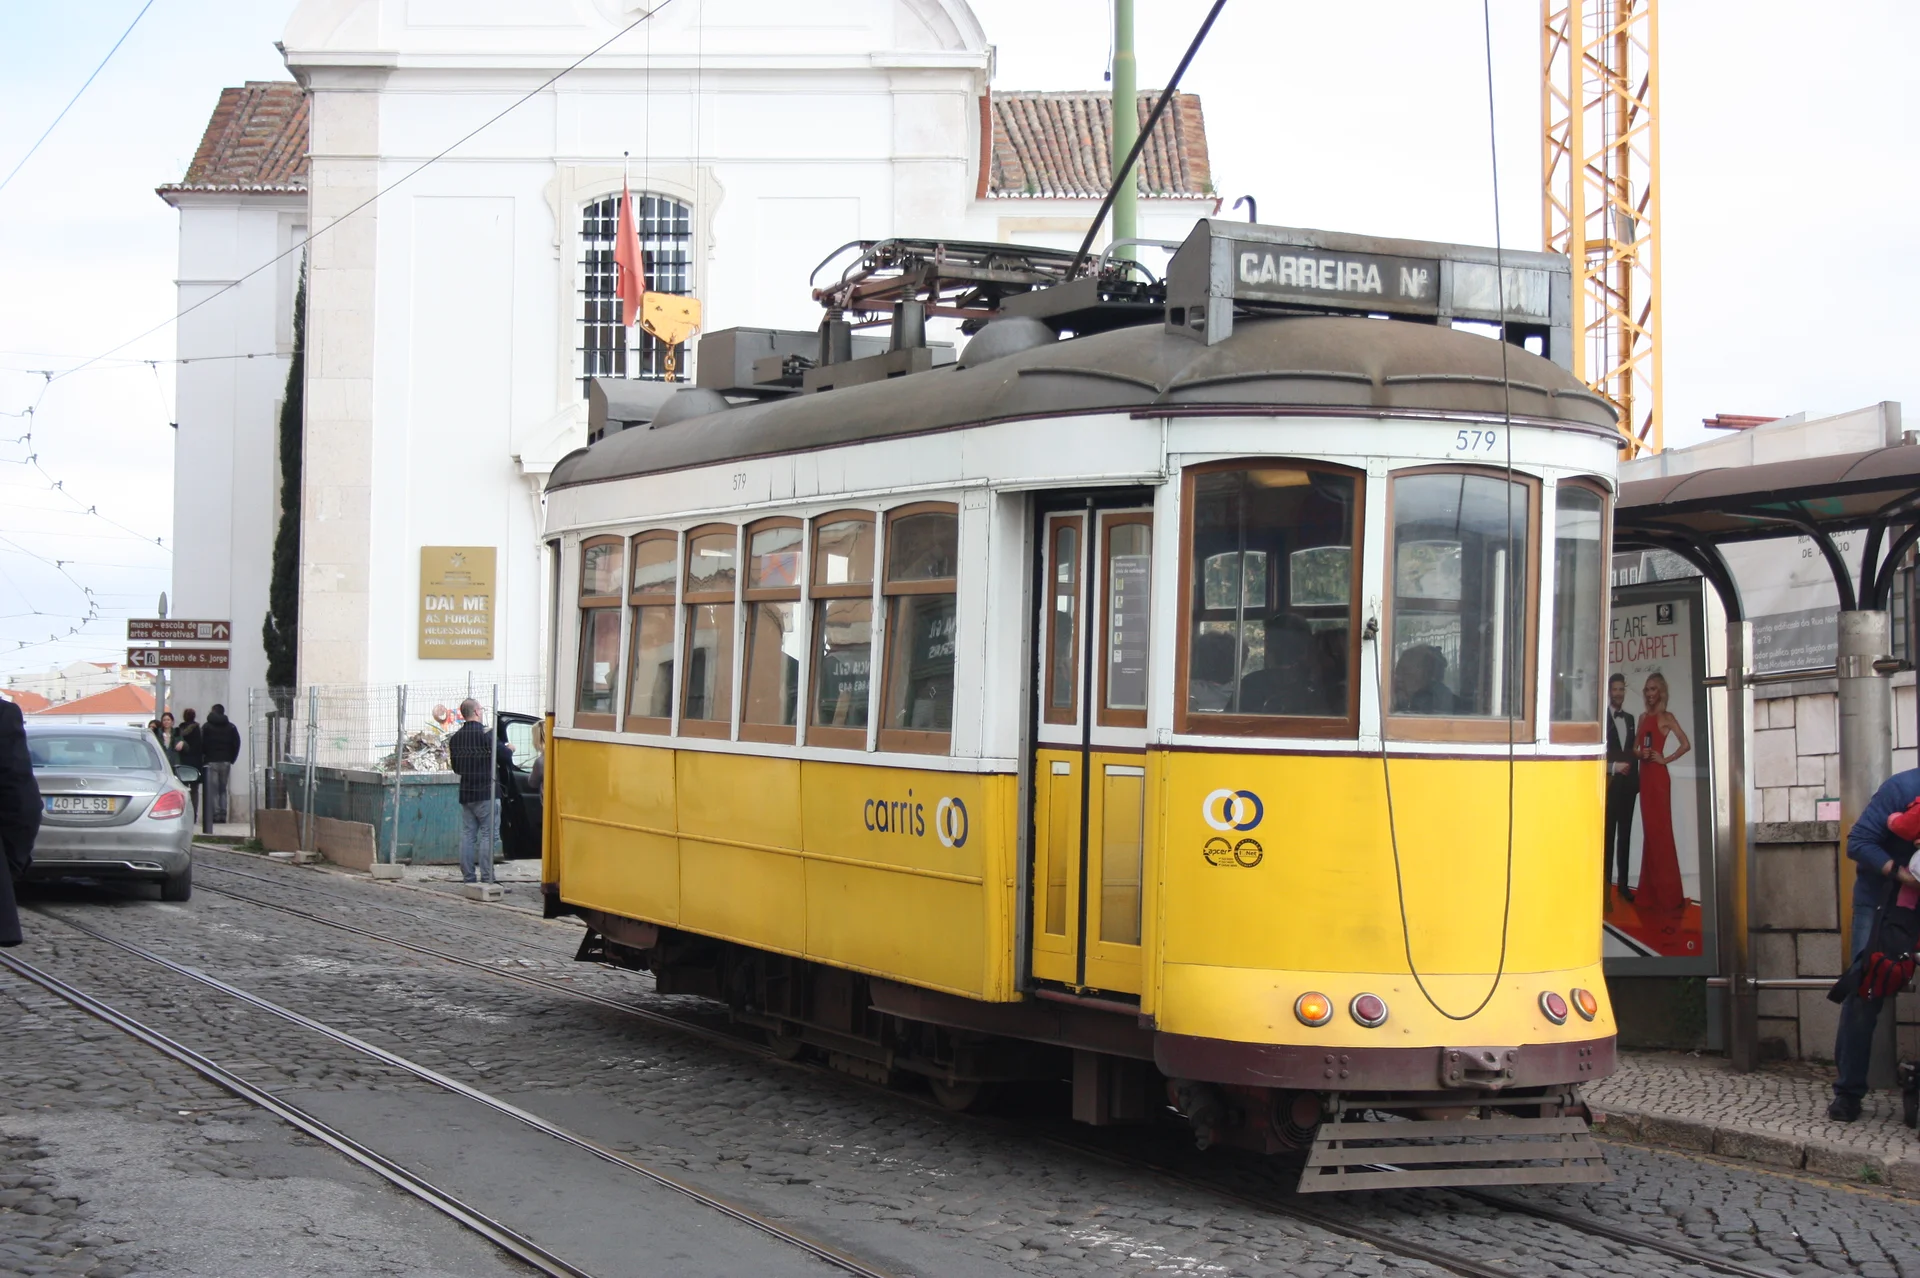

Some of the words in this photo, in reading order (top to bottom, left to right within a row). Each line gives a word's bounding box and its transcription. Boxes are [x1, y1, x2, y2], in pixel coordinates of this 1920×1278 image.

[1240, 253, 1382, 294] CARREIRA
[1456, 430, 1496, 451] 579
[733, 473, 747, 490] 579
[1802, 548, 1812, 558] DE
[425, 613, 441, 623] AS
[445, 613, 489, 625] FORÇAS
[1811, 617, 1824, 625] Rua
[152, 630, 195, 638] decorativas
[1610, 618, 1620, 640] E
[1624, 616, 1648, 638] ARE
[1763, 636, 1771, 644] 29
[1609, 641, 1624, 664] ED
[1628, 634, 1679, 661] CARPET
[160, 654, 185, 662] castelo
[188, 654, 196, 662] de
[200, 654, 207, 662] S.
[864, 788, 925, 837] carris
